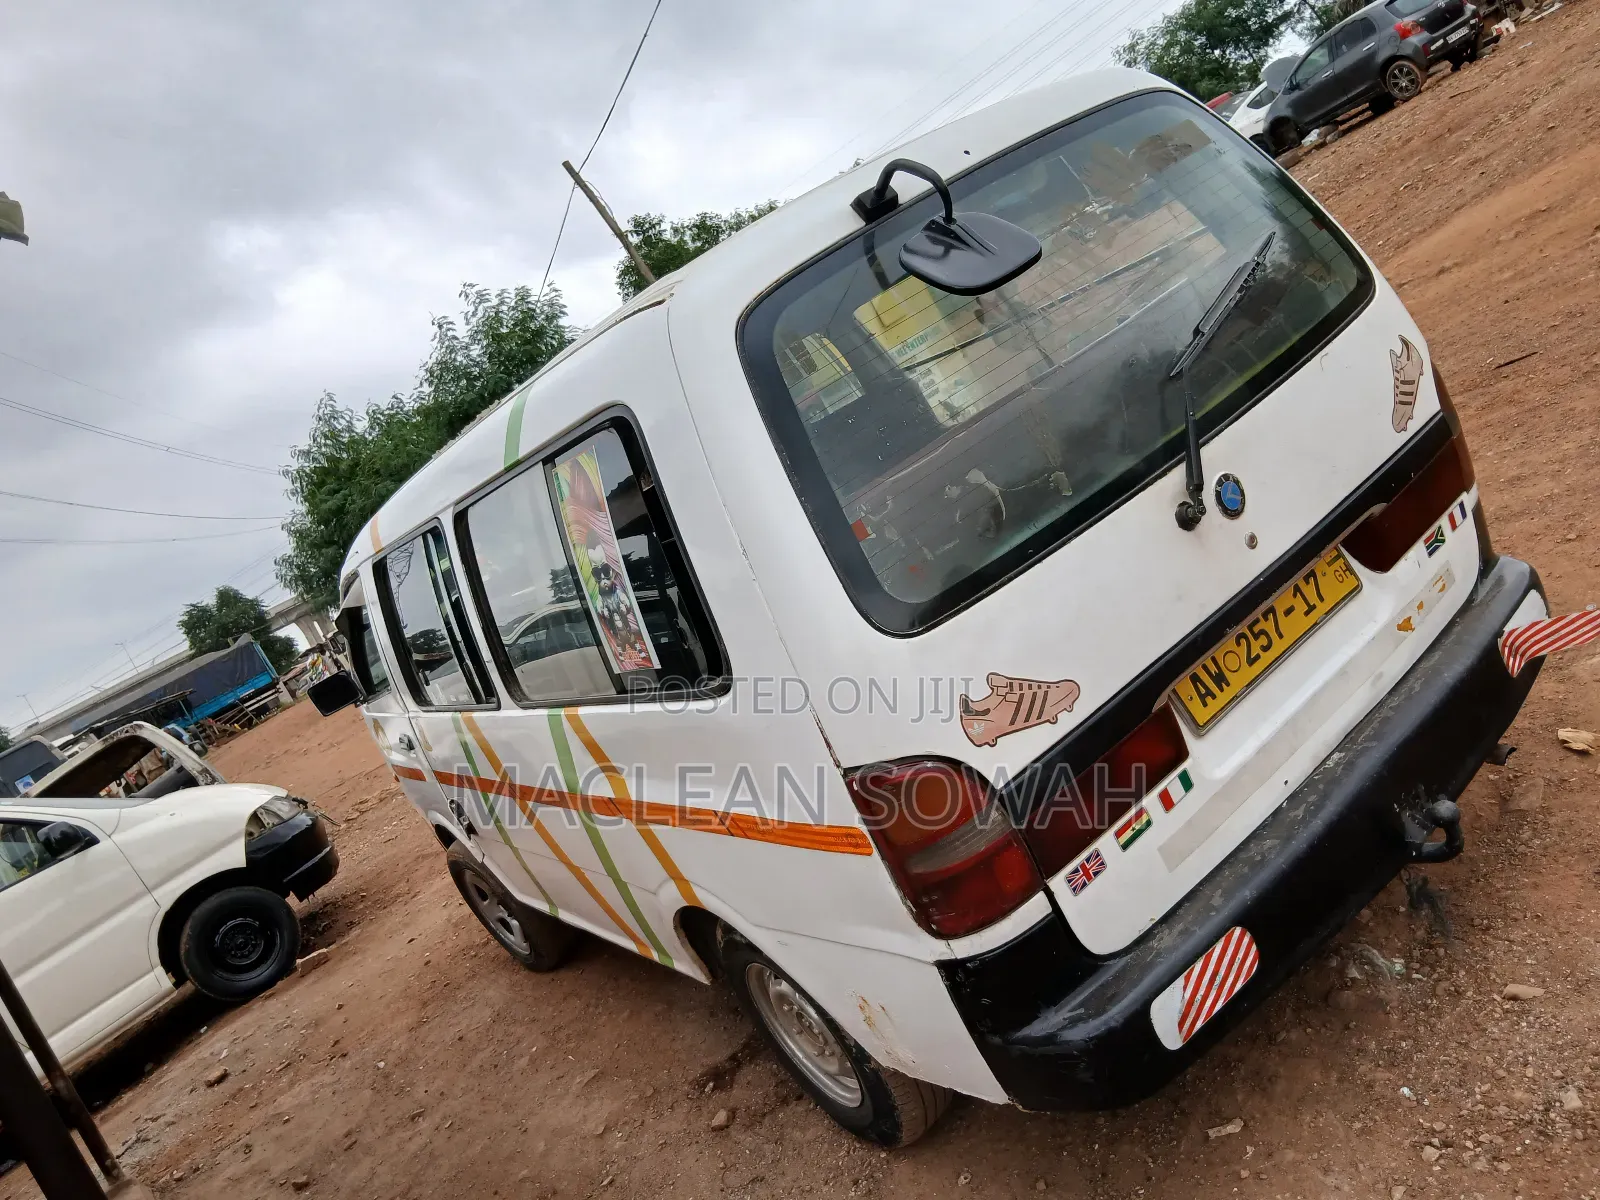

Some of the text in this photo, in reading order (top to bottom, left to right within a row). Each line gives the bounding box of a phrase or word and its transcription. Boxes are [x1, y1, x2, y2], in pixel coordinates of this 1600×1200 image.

[1334, 565, 1354, 583] GH
[1188, 569, 1325, 708] AW 257-17
